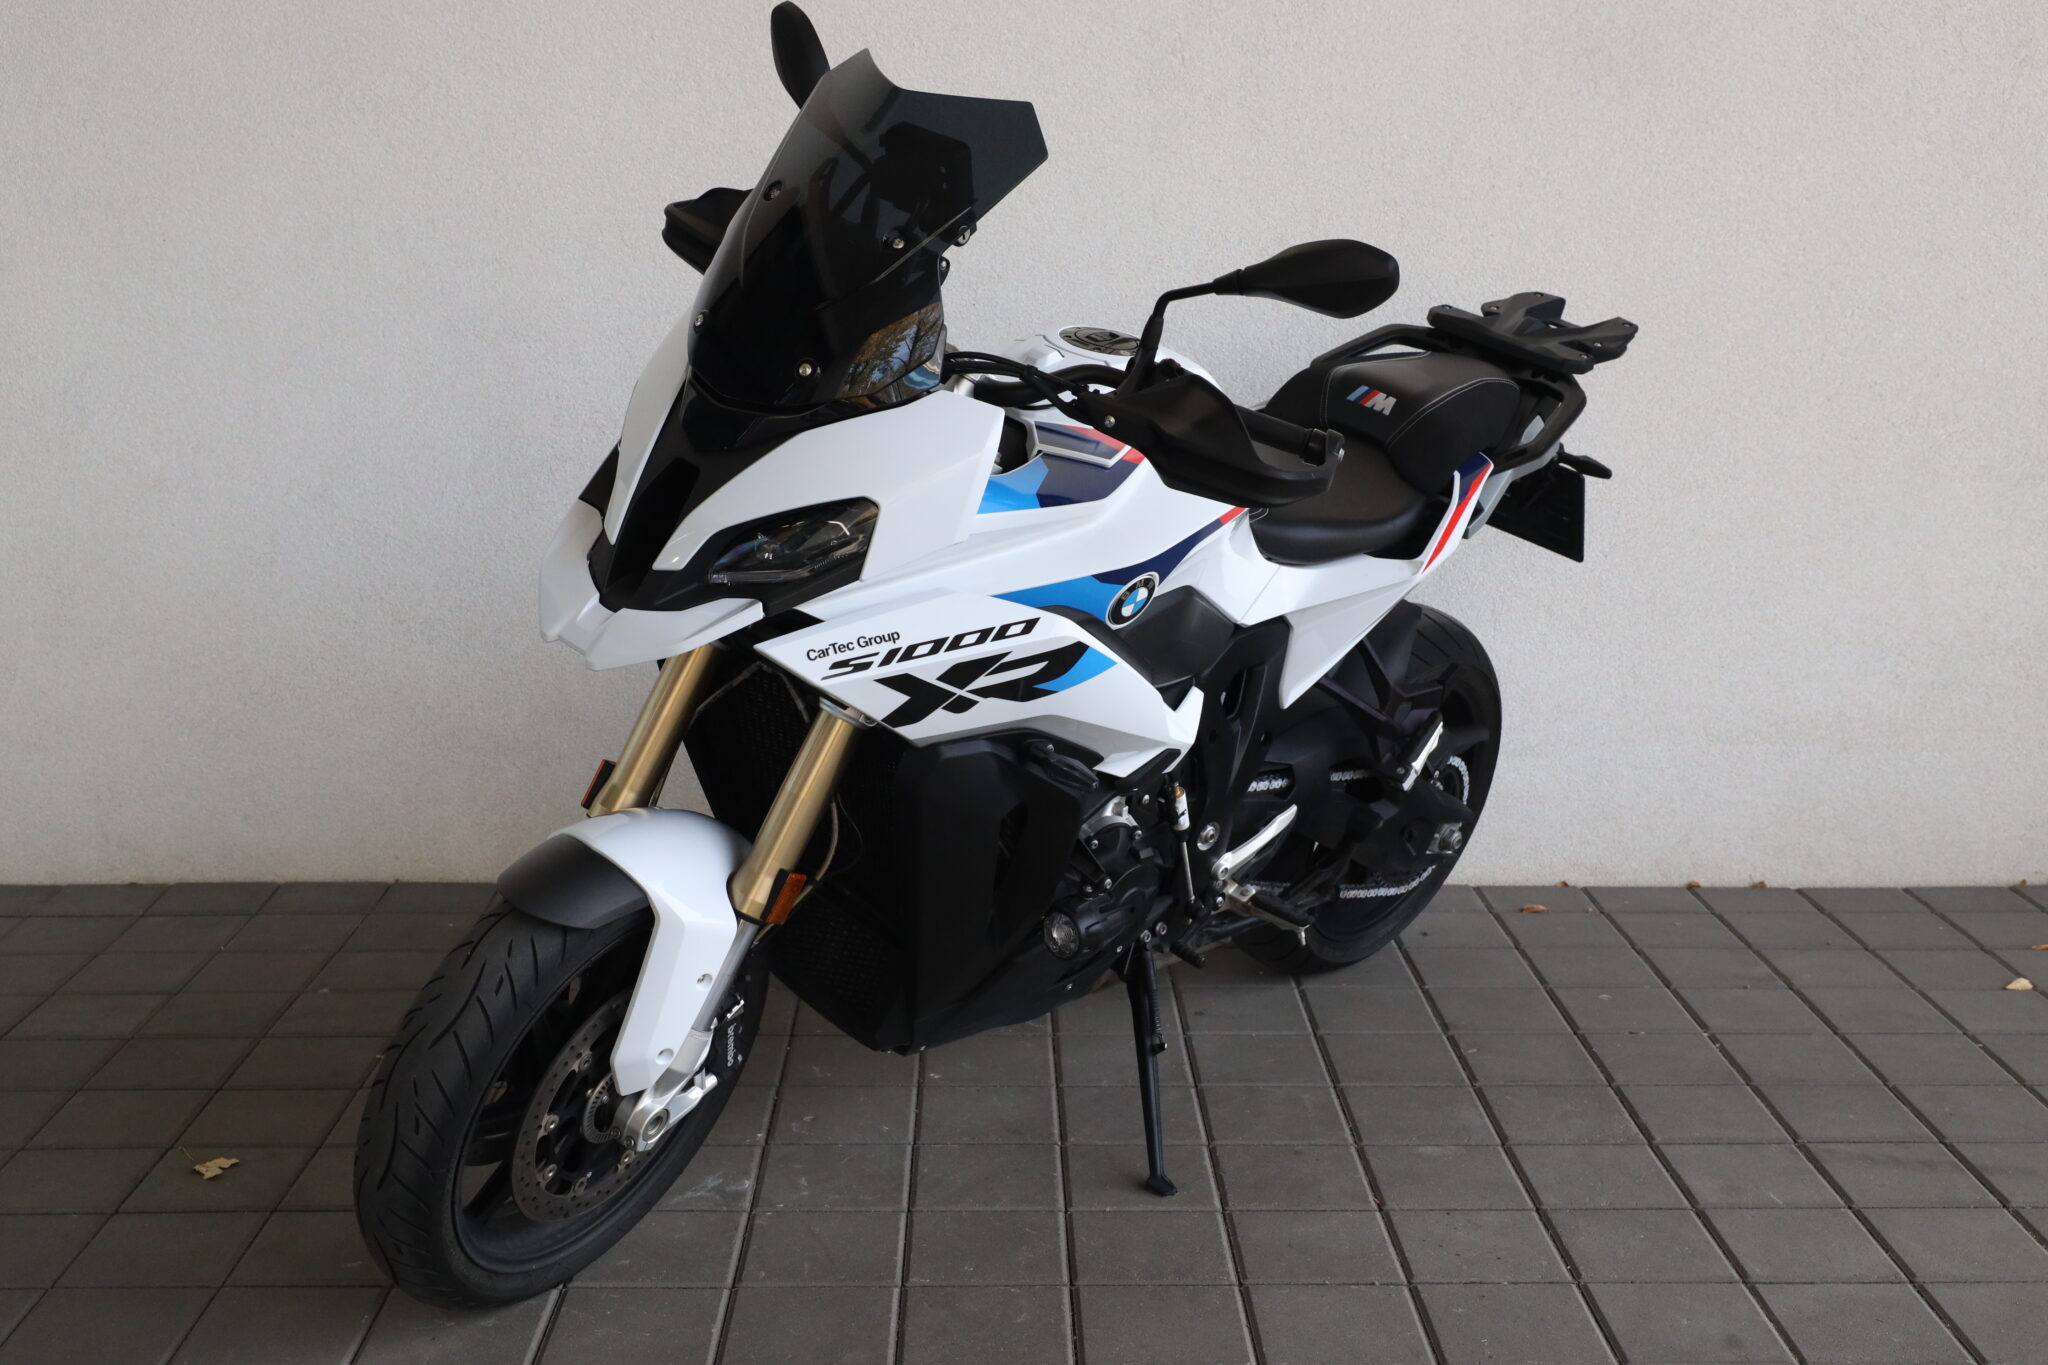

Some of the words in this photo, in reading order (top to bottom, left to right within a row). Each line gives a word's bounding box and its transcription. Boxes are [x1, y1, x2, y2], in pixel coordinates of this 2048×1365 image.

[1346, 385, 1397, 416] M
[1120, 578, 1155, 600] BMW
[806, 642, 855, 661] CarTec
[856, 631, 901, 649] Group
[821, 617, 1041, 680] S1000
[873, 640, 1102, 728] XR
[727, 1022, 737, 1067] brembo
